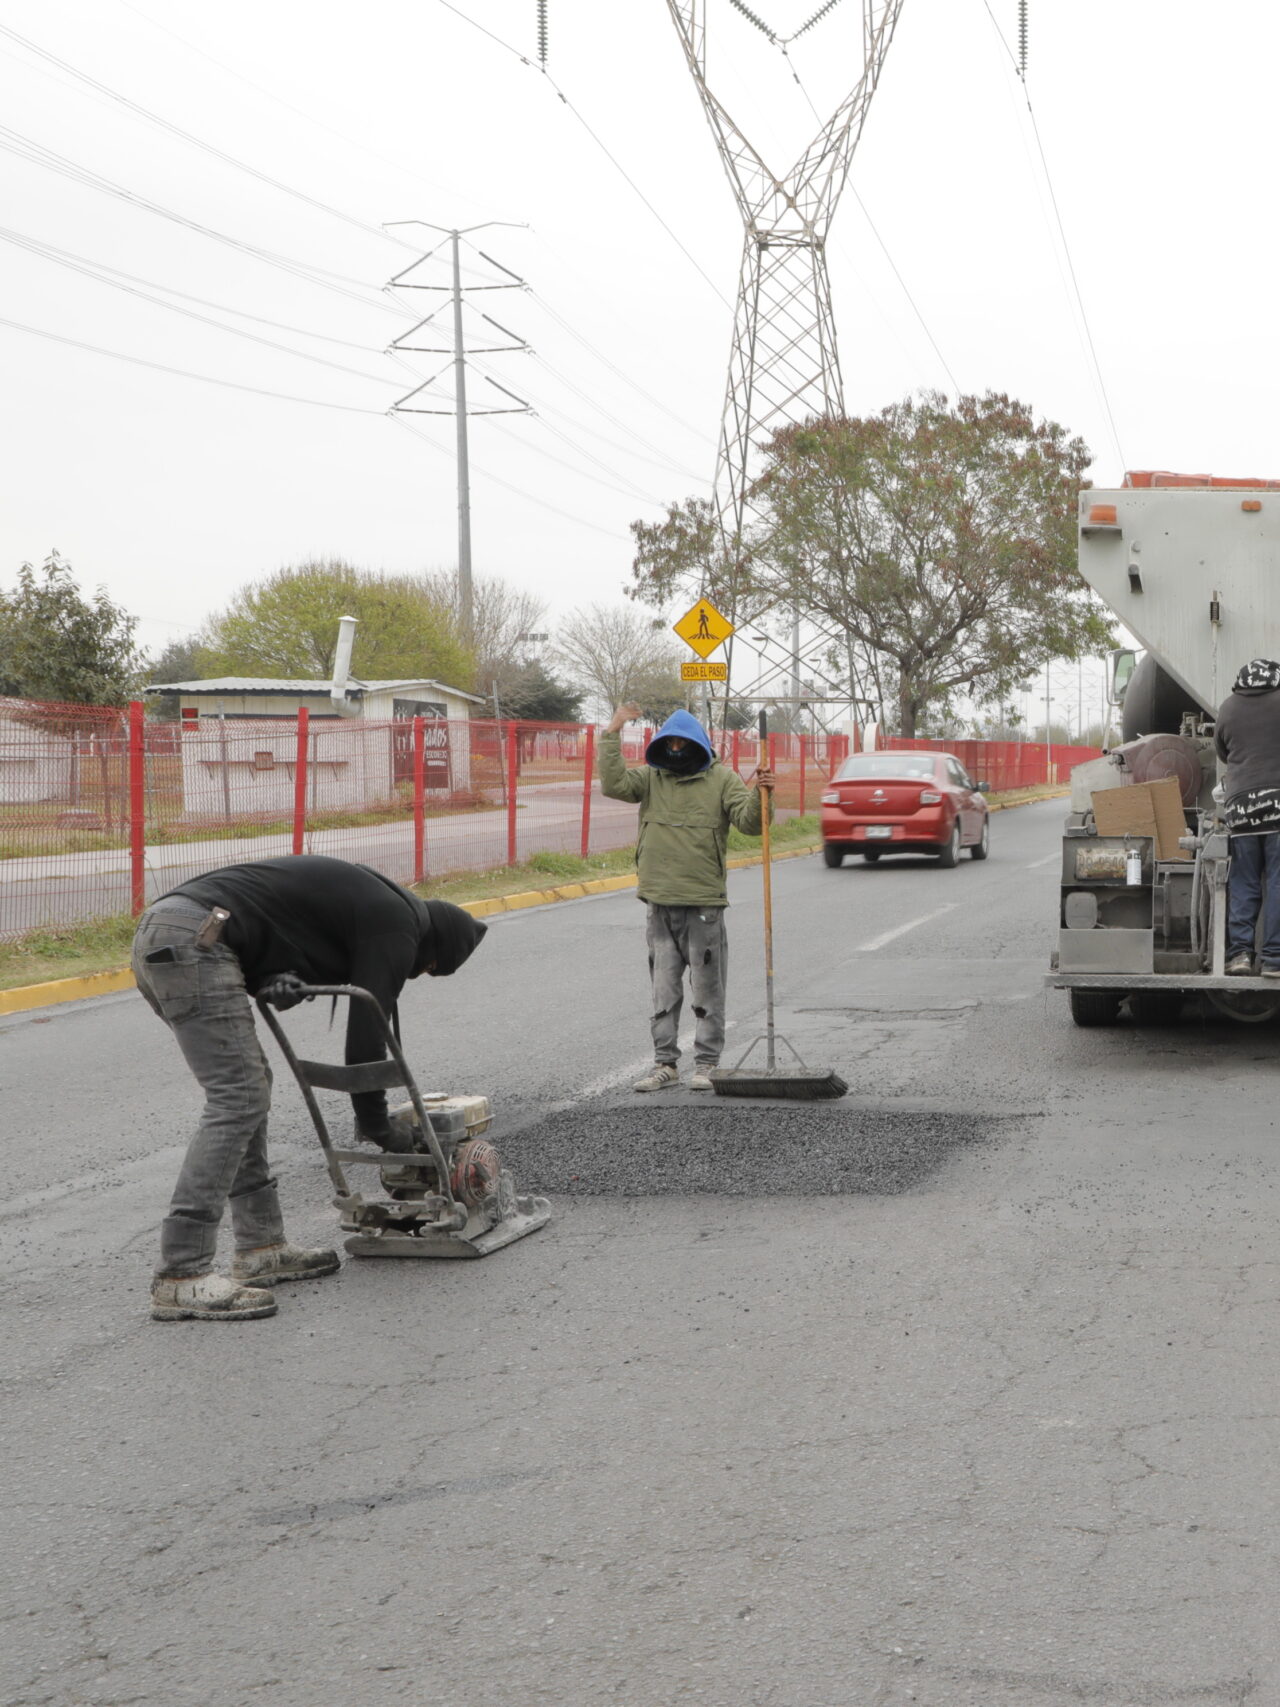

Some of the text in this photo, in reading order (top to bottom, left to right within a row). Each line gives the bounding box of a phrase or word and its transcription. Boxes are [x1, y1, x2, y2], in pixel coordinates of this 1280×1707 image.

[683, 666, 725, 677] CEDA EL PASO
